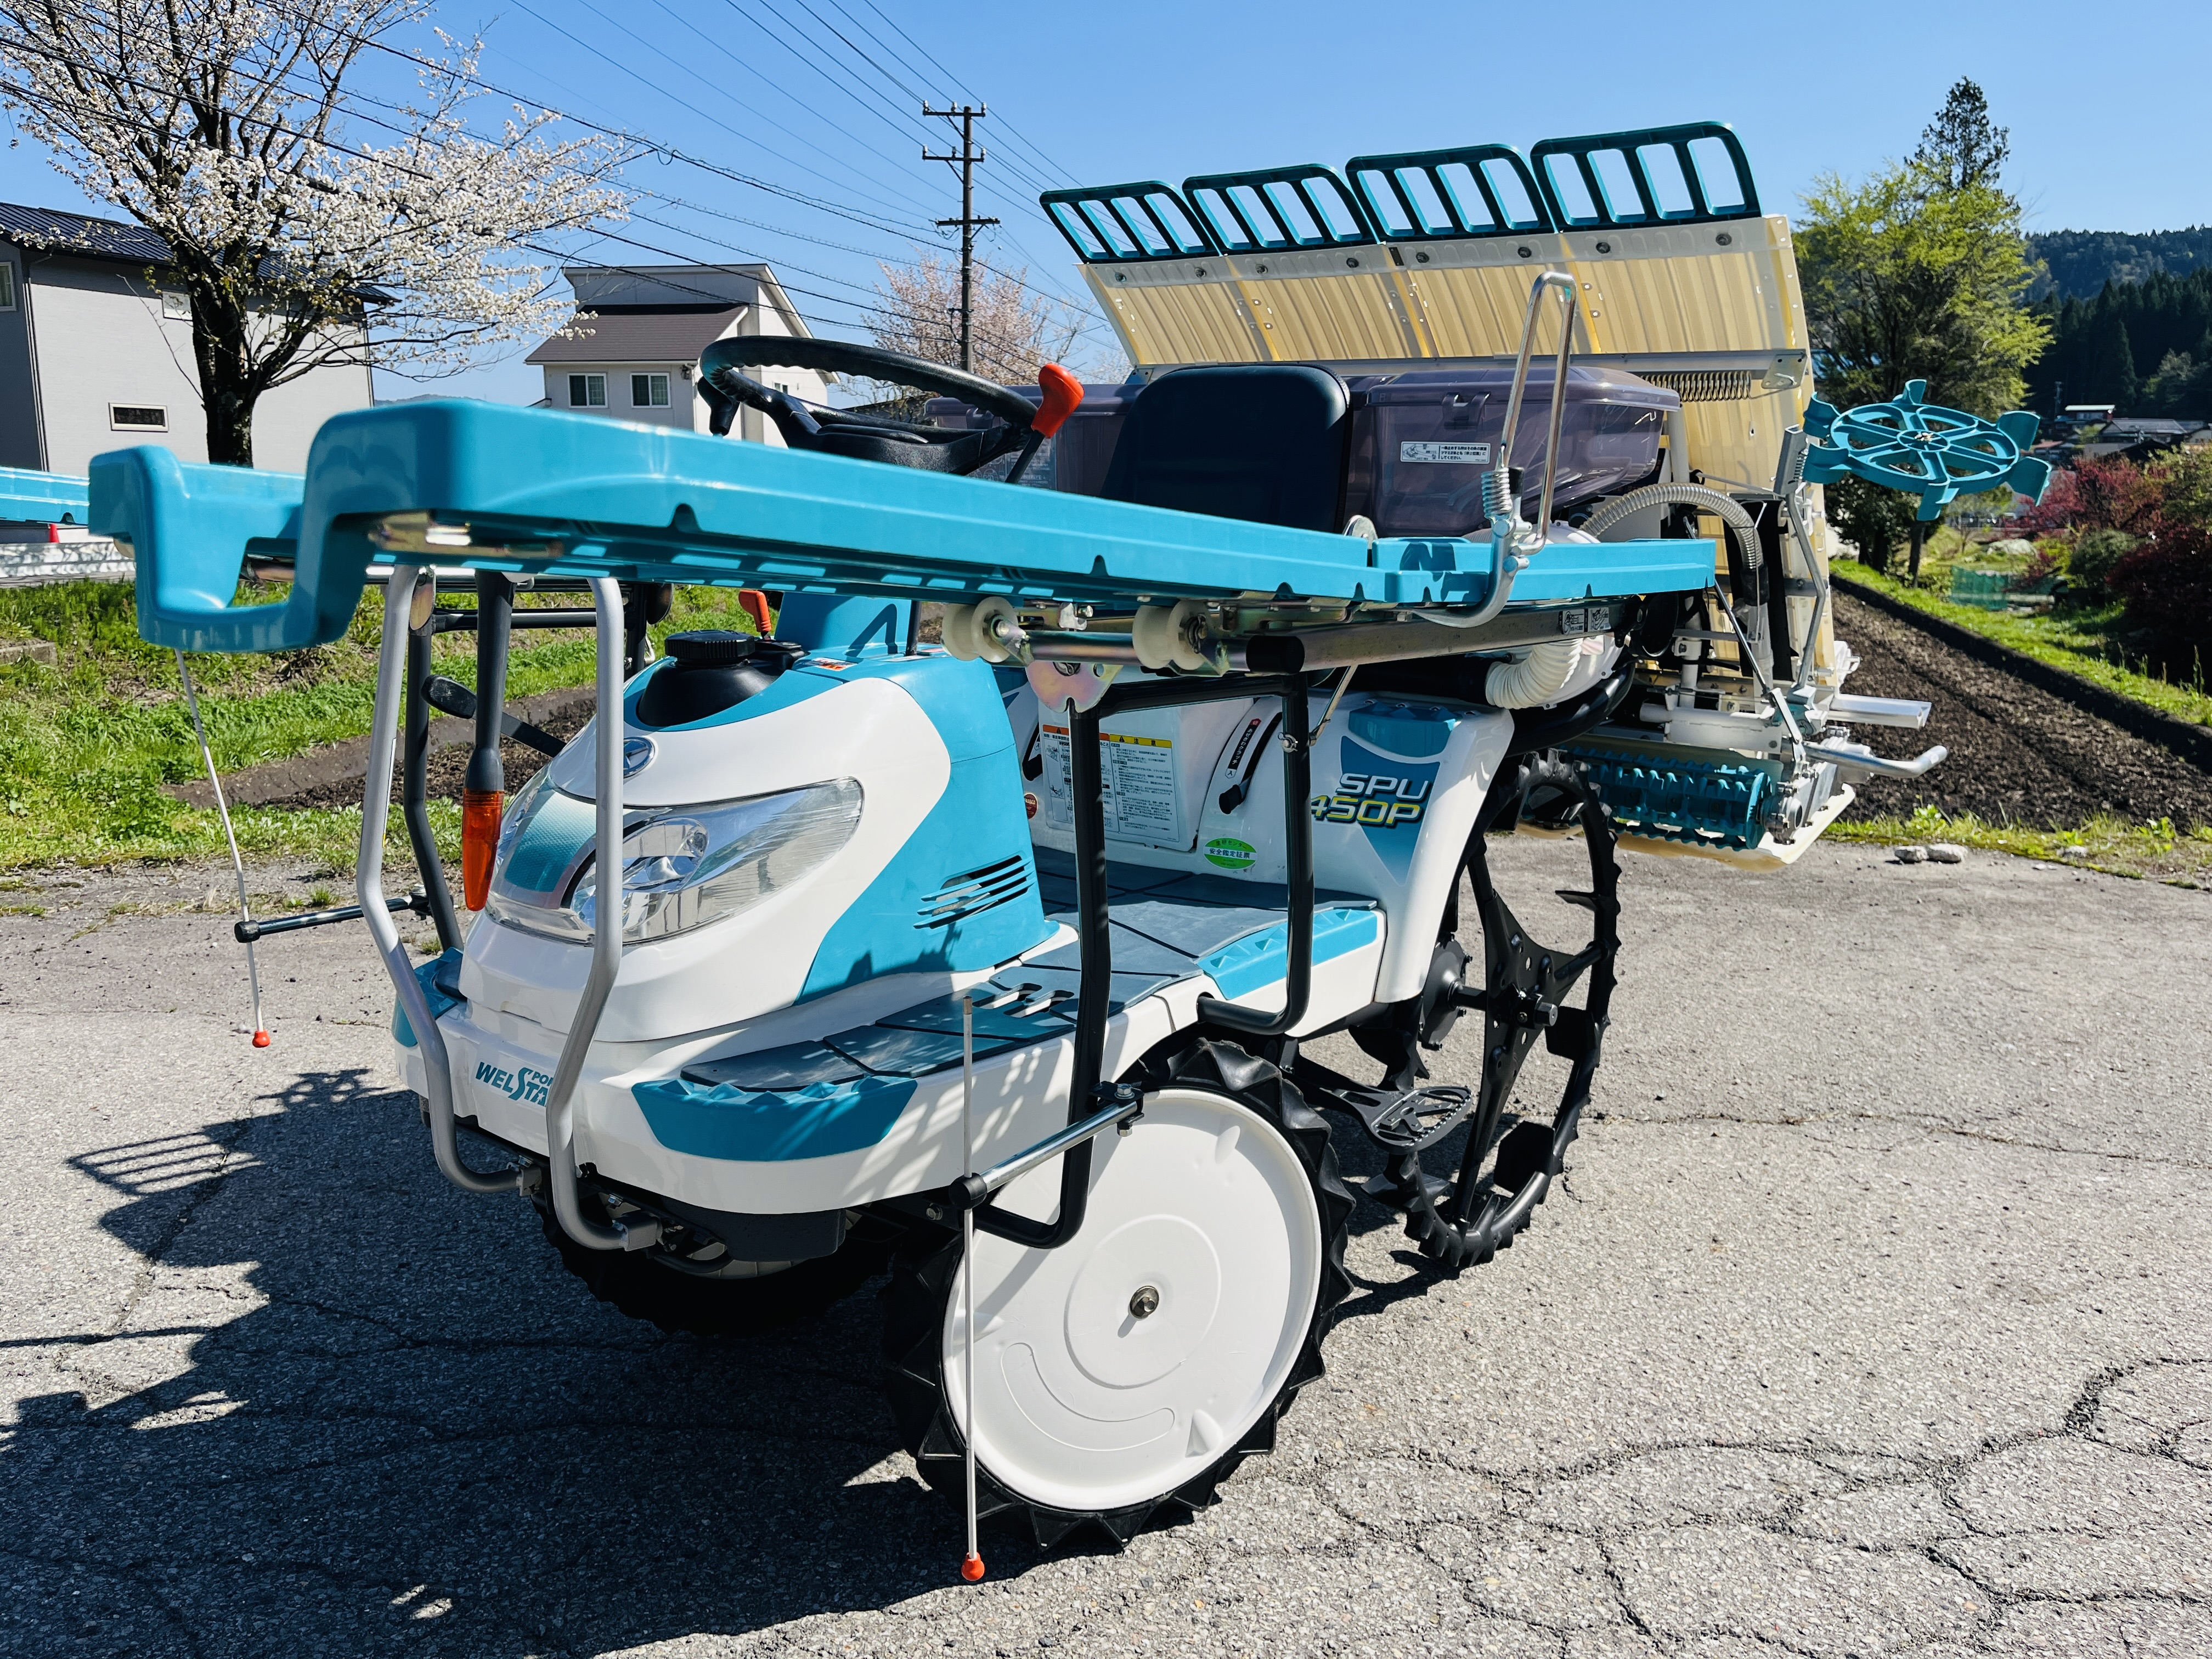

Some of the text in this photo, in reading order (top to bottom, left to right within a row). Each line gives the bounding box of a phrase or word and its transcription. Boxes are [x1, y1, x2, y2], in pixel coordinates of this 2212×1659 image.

[1335, 772, 1430, 799] SPU
[1311, 795, 1422, 826] 450P
[475, 1062, 548, 1107] WELSTA
